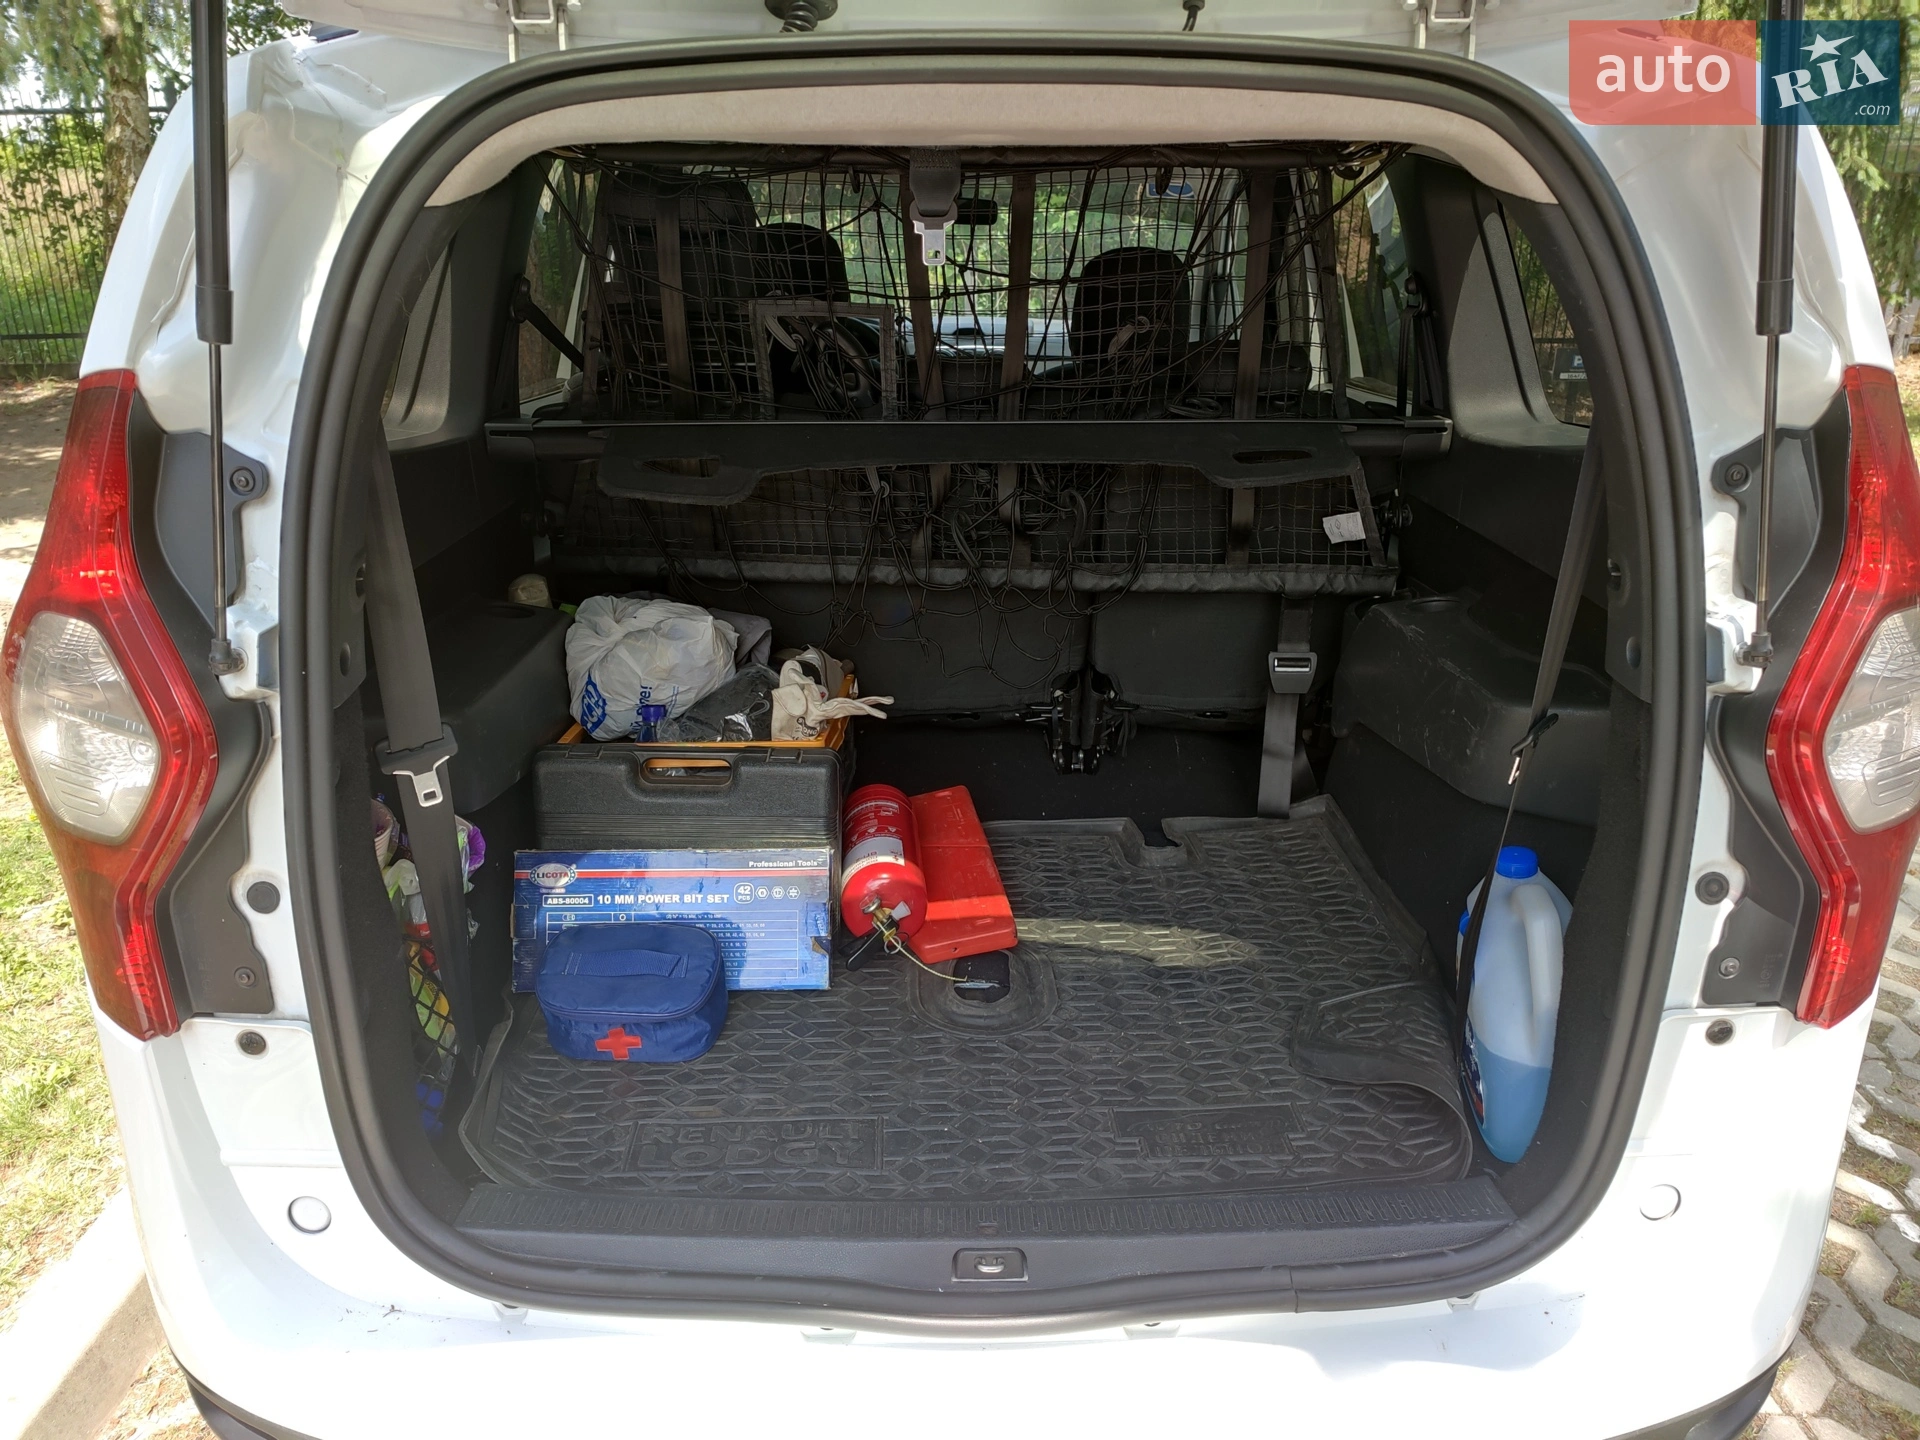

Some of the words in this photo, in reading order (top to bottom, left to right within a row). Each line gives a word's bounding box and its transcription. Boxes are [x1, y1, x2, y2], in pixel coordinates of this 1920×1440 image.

[749, 860, 796, 868] Professional
[536, 871, 570, 879] LICOTA
[737, 885, 751, 895] 42
[546, 897, 589, 905] ABS-80004
[597, 895, 612, 905] 10
[614, 894, 635, 905] MM
[638, 894, 680, 905] POWER
[684, 893, 706, 904] BIT
[706, 894, 730, 904] SET
[640, 1122, 860, 1145] RENAULT
[637, 1139, 865, 1168] LODGY
